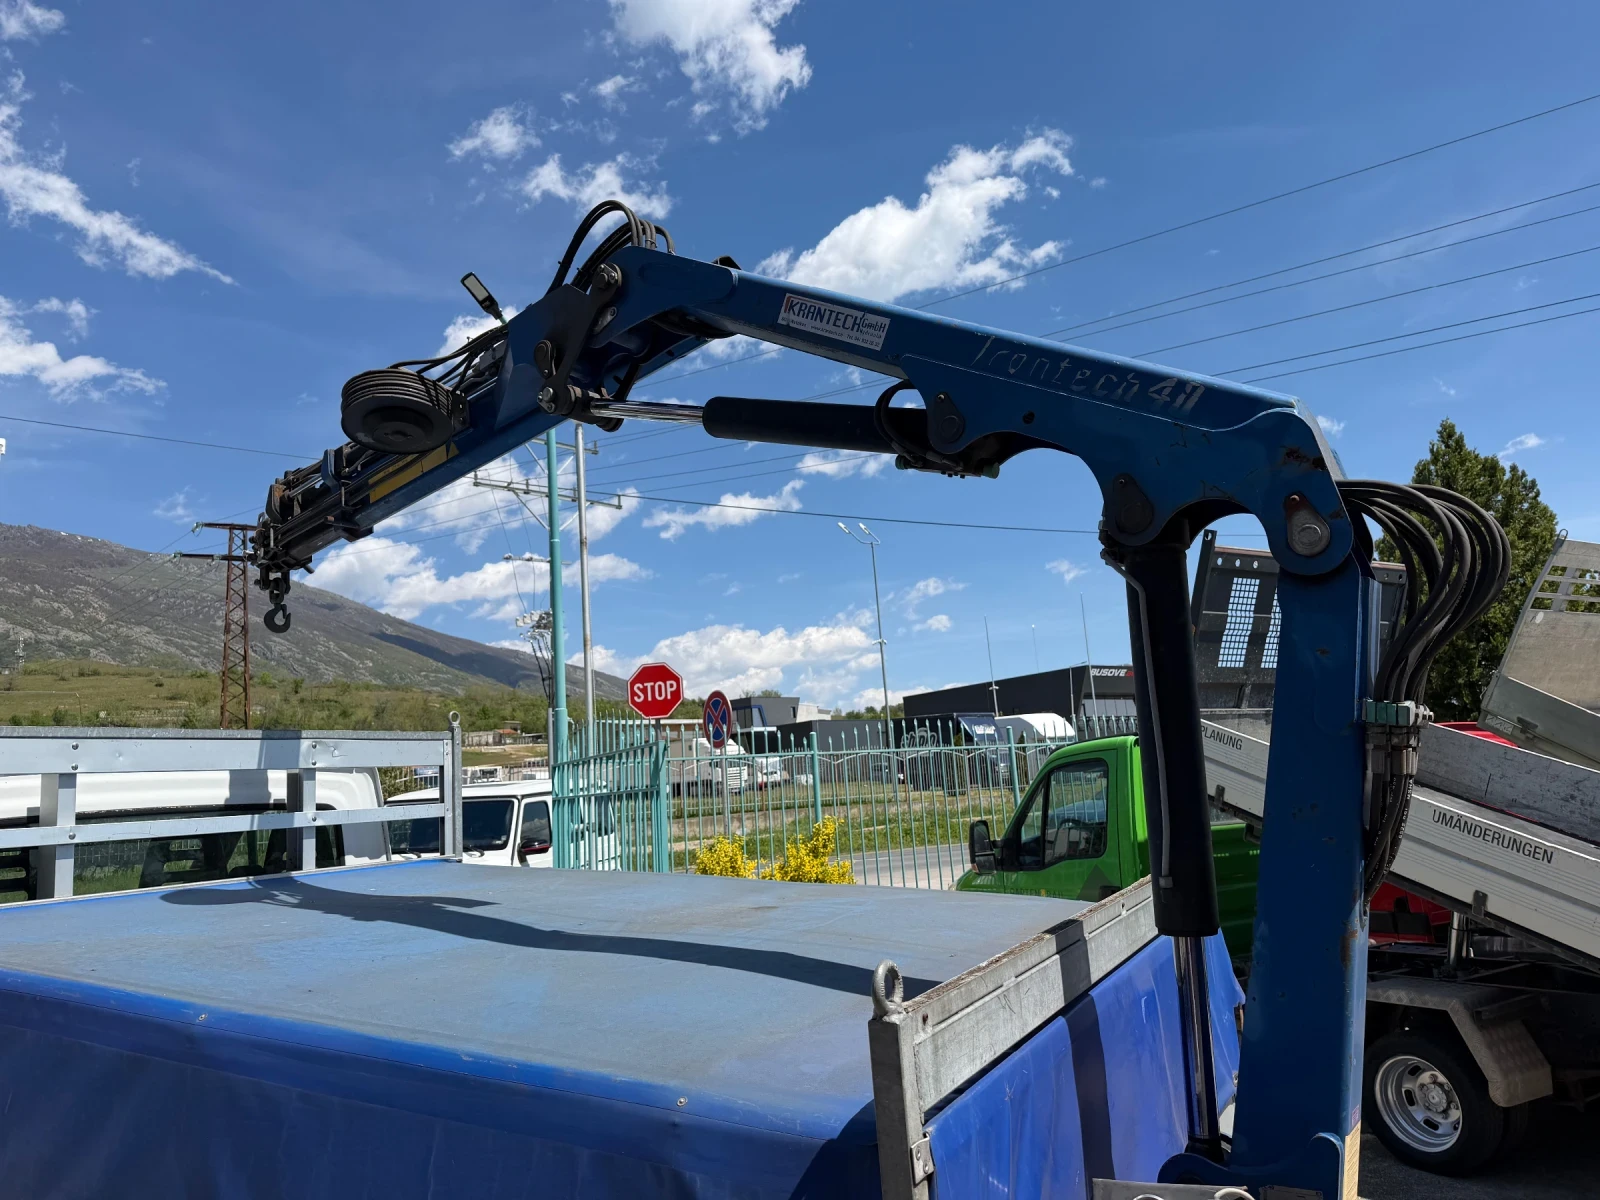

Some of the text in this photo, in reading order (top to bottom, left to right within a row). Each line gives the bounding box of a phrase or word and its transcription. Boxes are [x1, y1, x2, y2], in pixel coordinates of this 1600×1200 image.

[788, 299, 863, 333] KRANTECH
[861, 318, 887, 333] GmbH
[633, 680, 677, 702] STOP
[1432, 809, 1553, 864] UMÄNDERUNGEN
